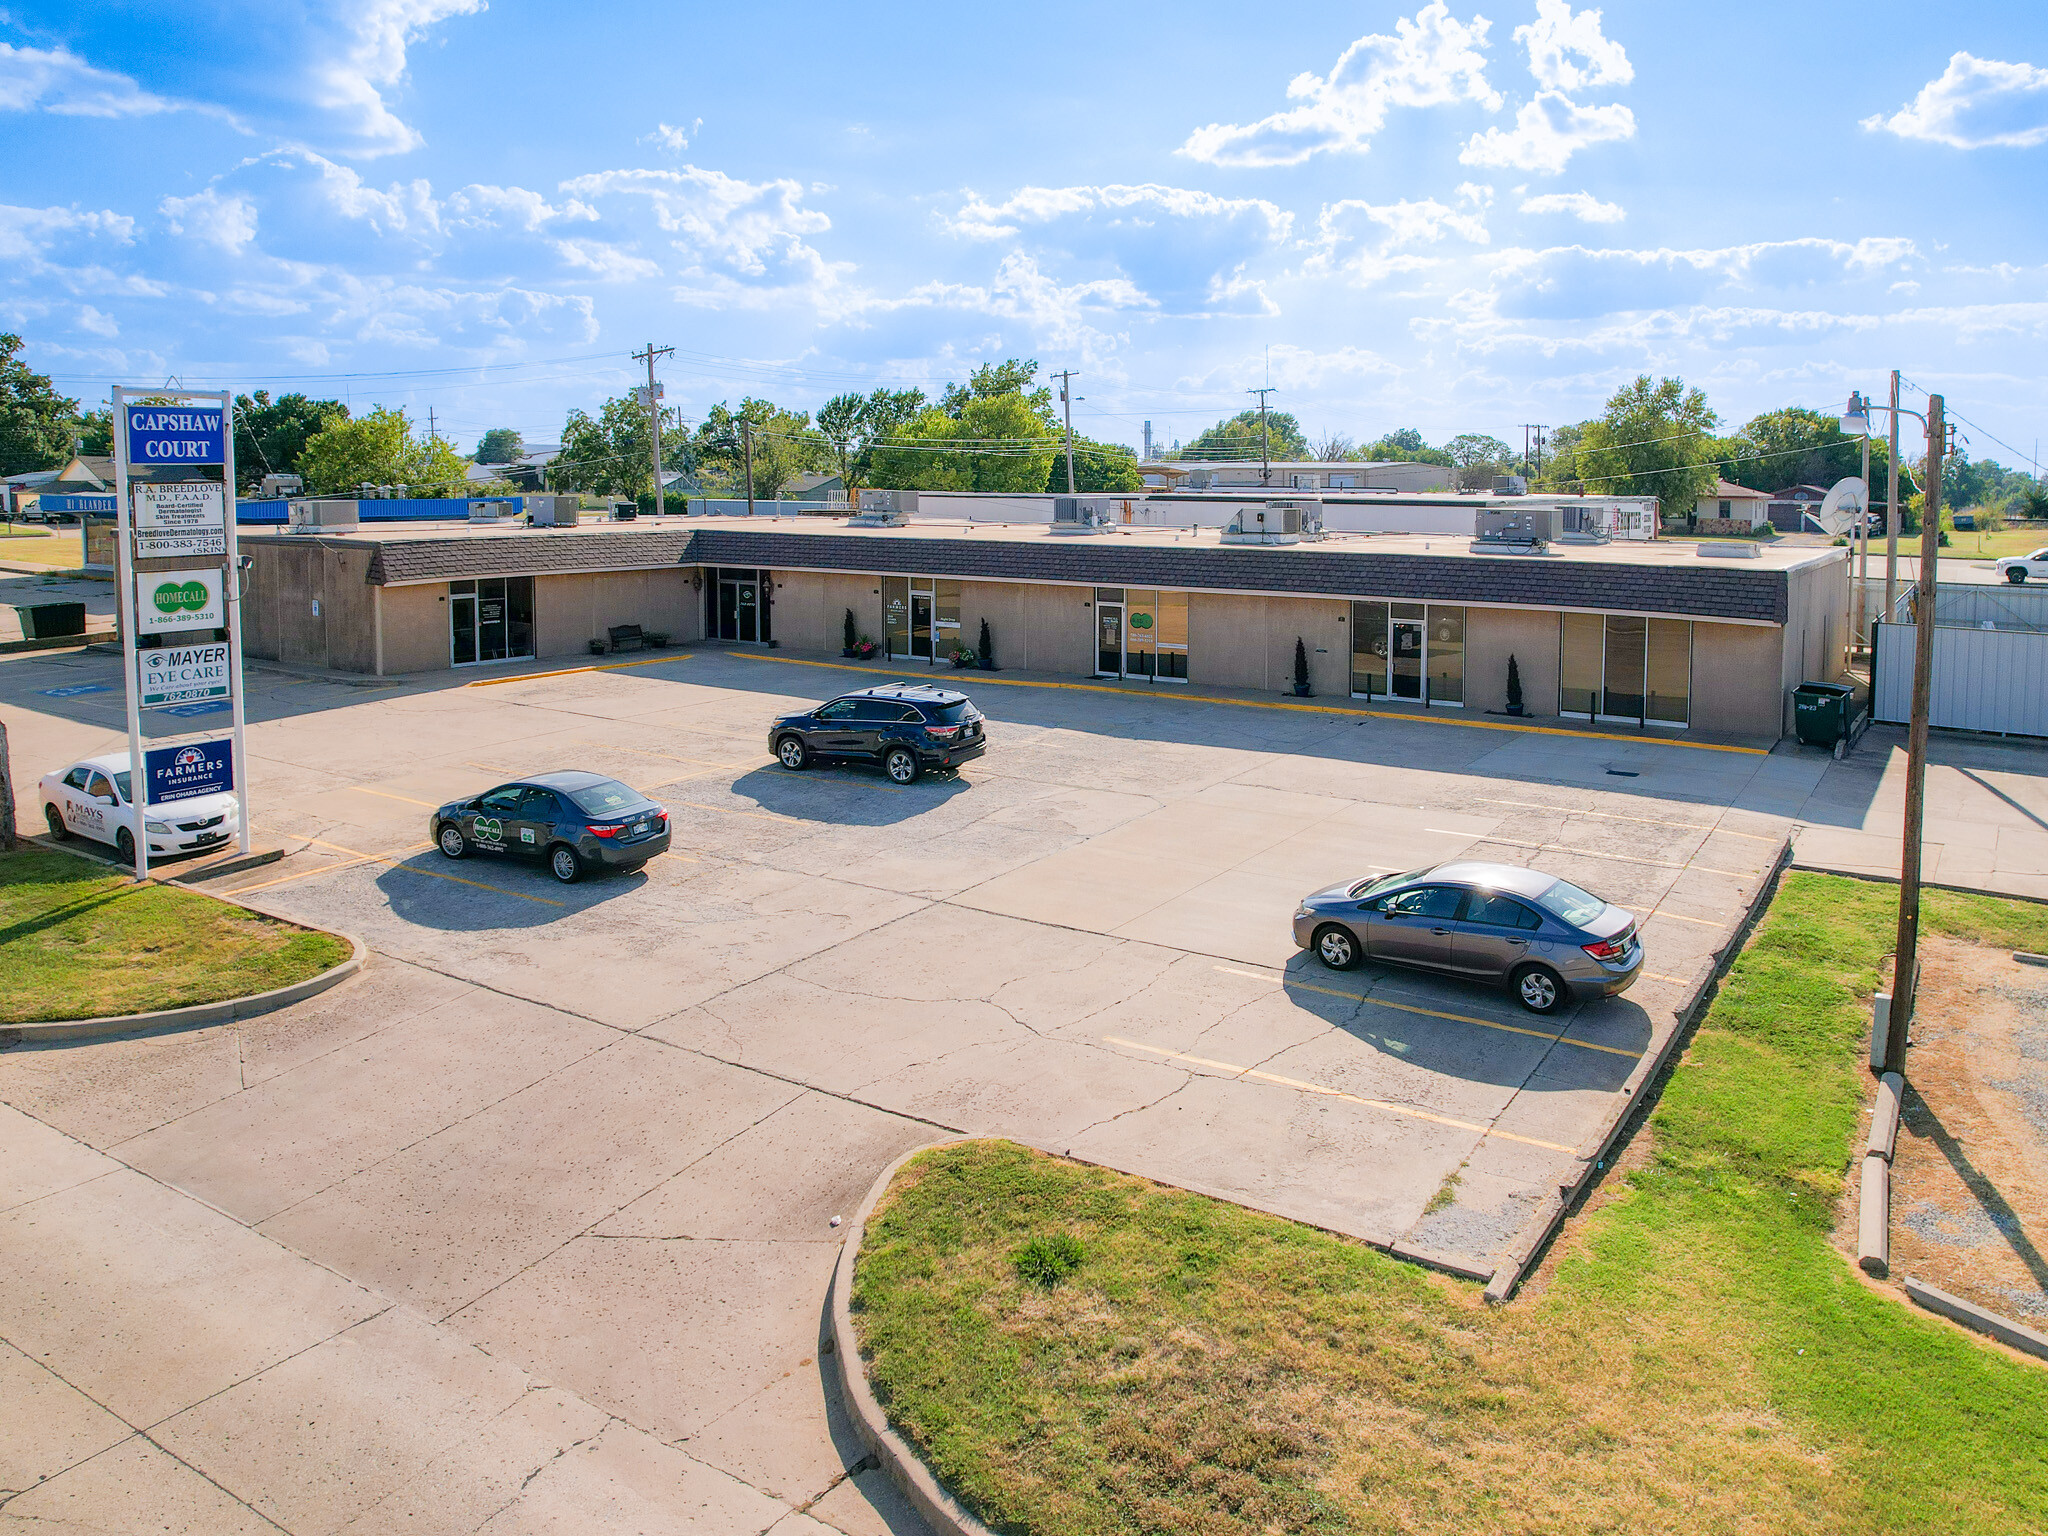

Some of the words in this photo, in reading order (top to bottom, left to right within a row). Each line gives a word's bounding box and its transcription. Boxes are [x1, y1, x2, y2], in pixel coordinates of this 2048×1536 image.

[131, 413, 220, 431] CAPSHAW
[145, 440, 210, 457] COURT
[135, 485, 157, 494] R.A.
[159, 484, 222, 493] BREEDLOVE
[137, 527, 224, 538] BreedloveDermatology.com
[139, 539, 222, 550] 1-800-383-7546
[193, 546, 225, 554] (SKIN)
[155, 590, 207, 604] HOMECALL
[149, 612, 214, 624] 1-866-389-5310
[168, 647, 225, 667] MAYER
[147, 670, 177, 685] EYE
[180, 665, 224, 681] CARE
[163, 689, 210, 701] 762-0870
[156, 760, 223, 779] FARMERS
[168, 773, 213, 785] INSURANCE
[160, 793, 176, 802] ERIN
[197, 785, 222, 794] AGENCY
[75, 803, 103, 819] MAYS
